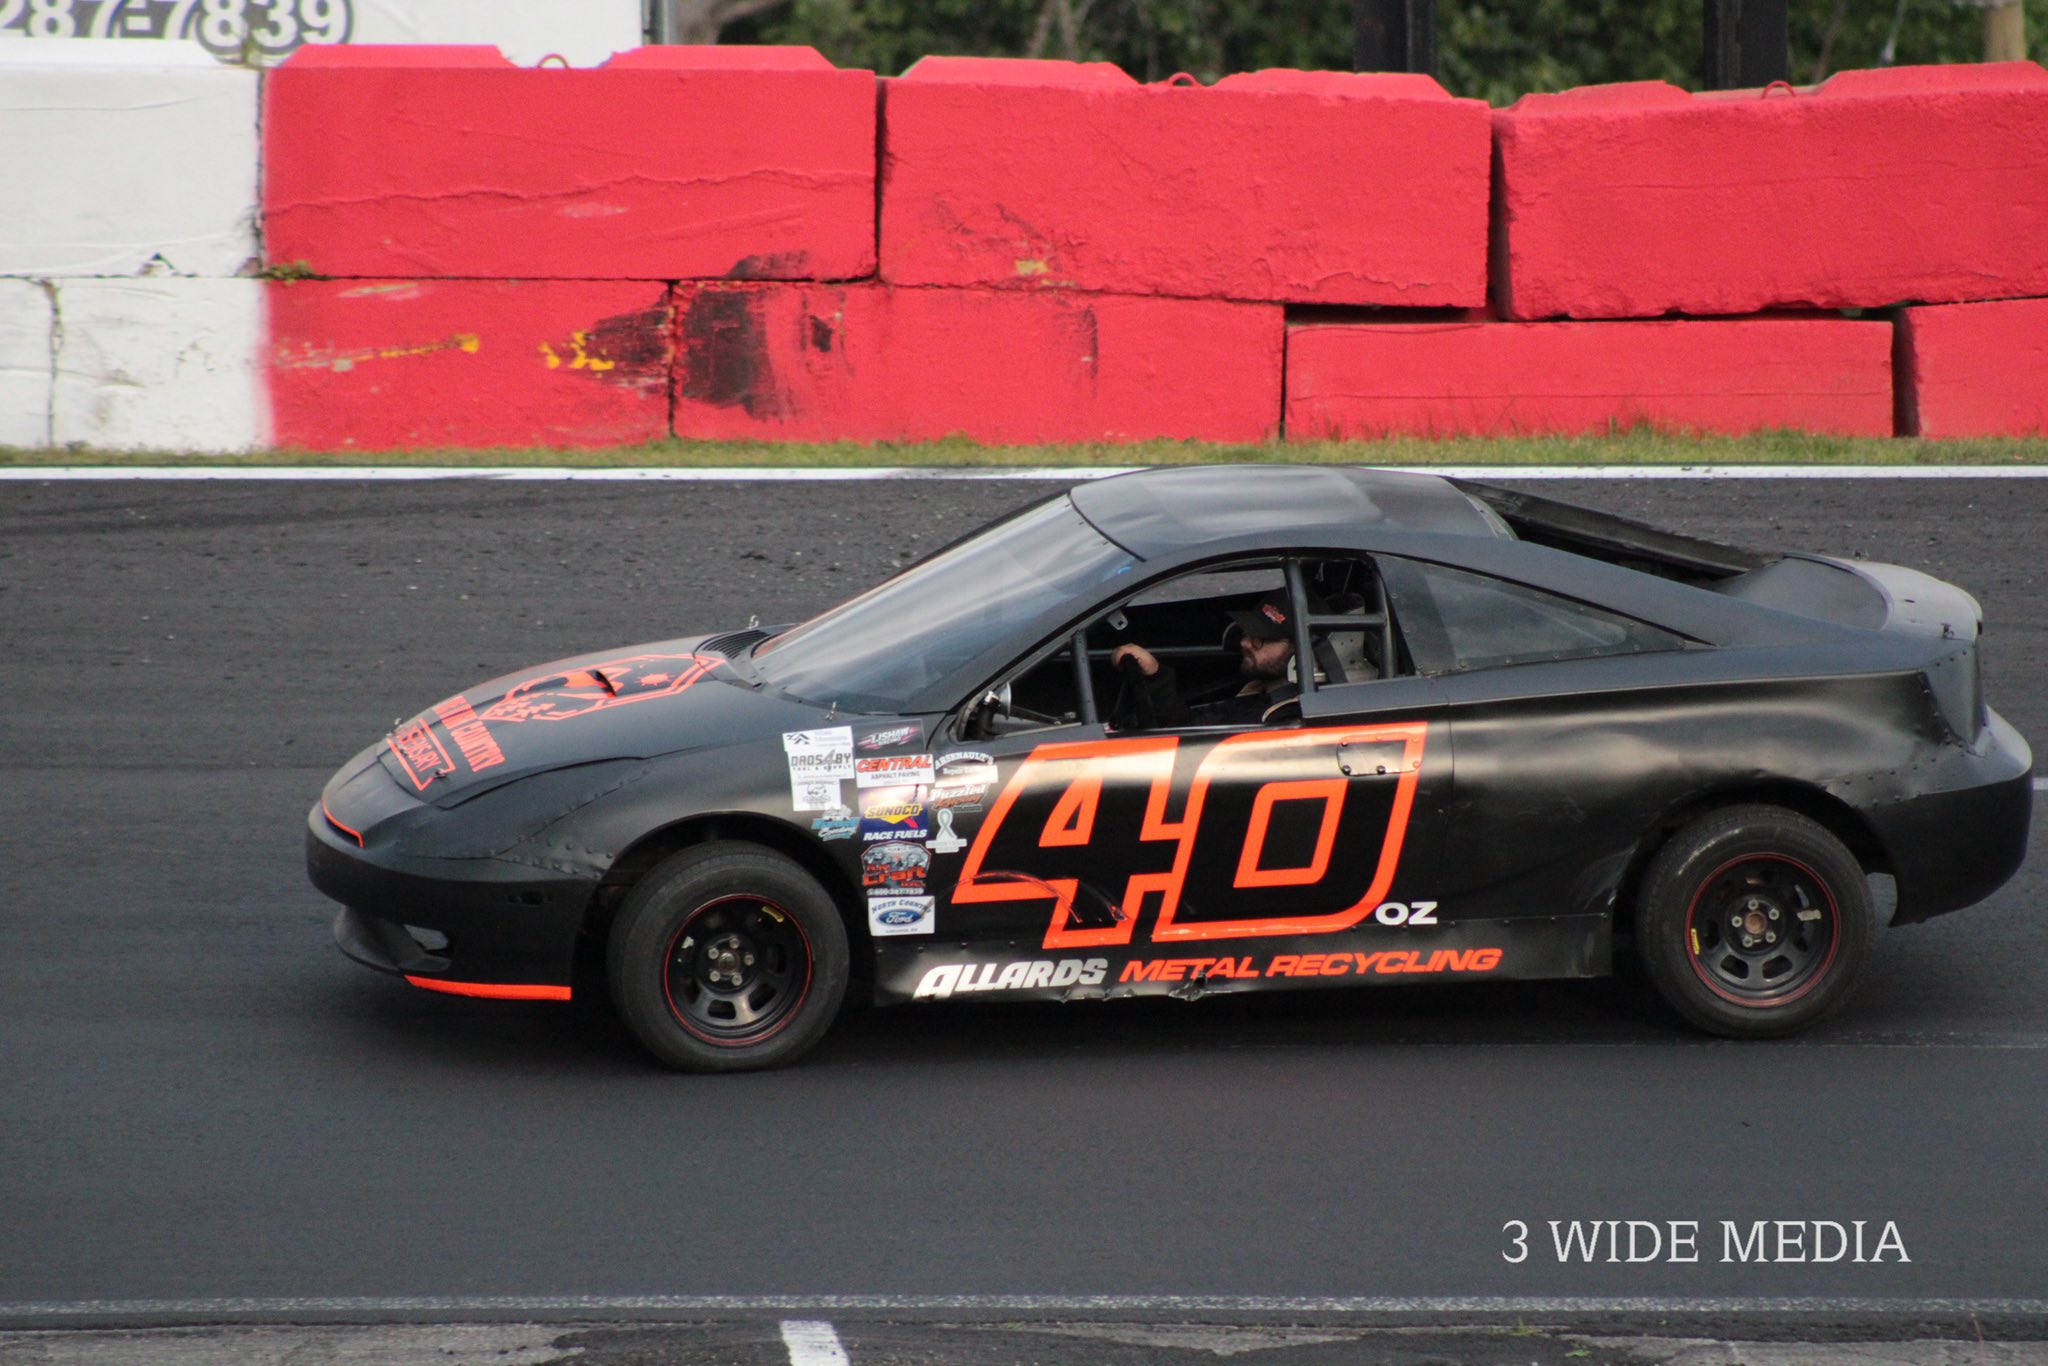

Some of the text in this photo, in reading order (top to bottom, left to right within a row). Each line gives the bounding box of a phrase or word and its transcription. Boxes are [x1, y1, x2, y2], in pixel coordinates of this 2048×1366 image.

[857, 755, 932, 773] CENTRAL
[867, 804, 920, 817] SUNOCO
[863, 831, 894, 841] RACE
[894, 829, 928, 840] FUELS
[951, 722, 1428, 949] 40
[886, 911, 913, 924] Ford
[1375, 901, 1438, 925] OZ
[912, 949, 1502, 999] ALLARDS METAL RECYCLING
